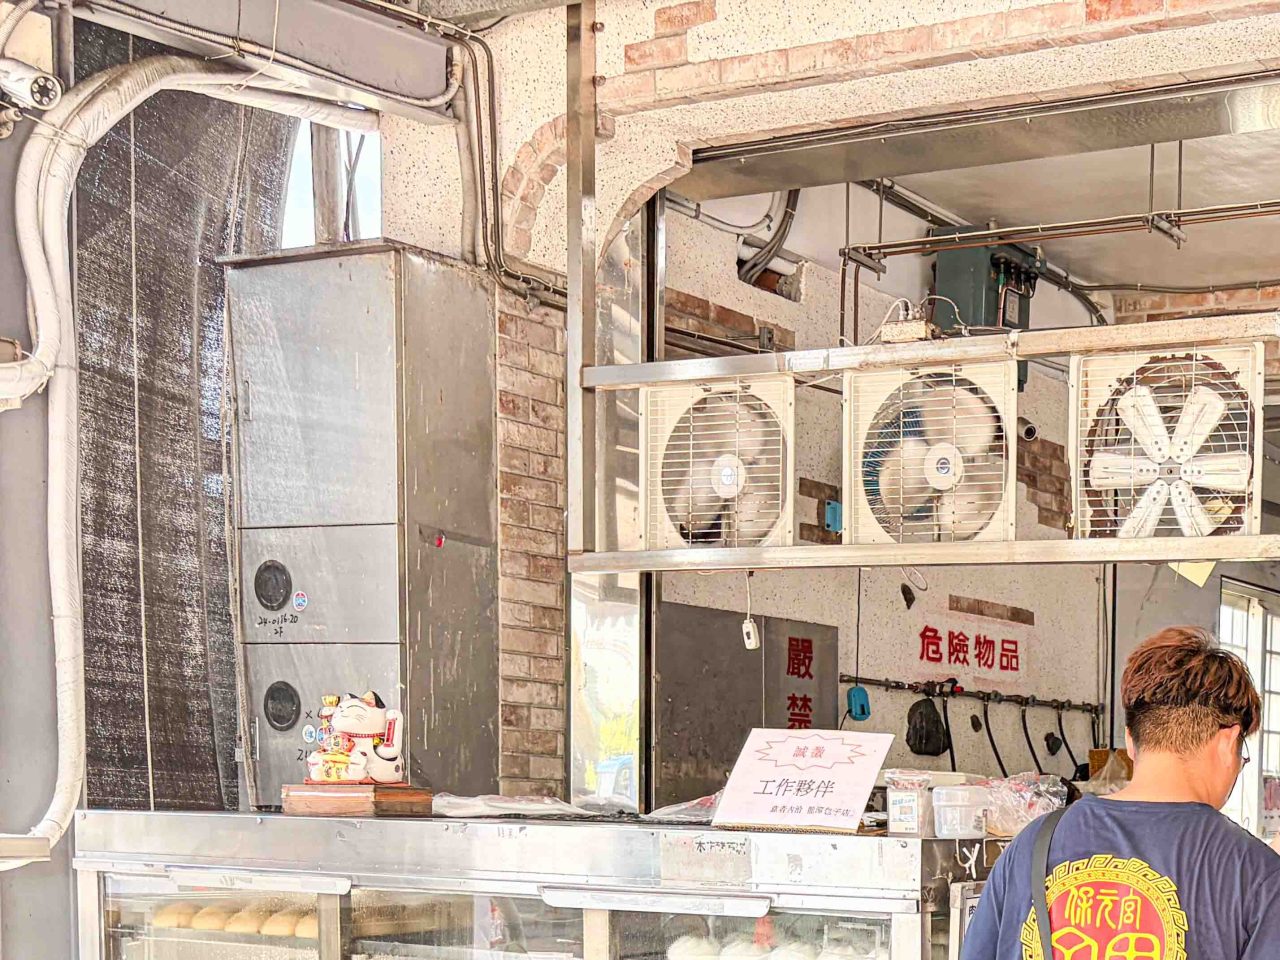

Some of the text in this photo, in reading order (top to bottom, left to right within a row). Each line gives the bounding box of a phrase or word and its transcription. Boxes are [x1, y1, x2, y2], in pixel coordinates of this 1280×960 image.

[918, 625, 1021, 672] 危險物品
[792, 745, 826, 759] 誠徵
[753, 778, 836, 798] 工作夥伴
[1065, 886, 1142, 930] 保元宮
